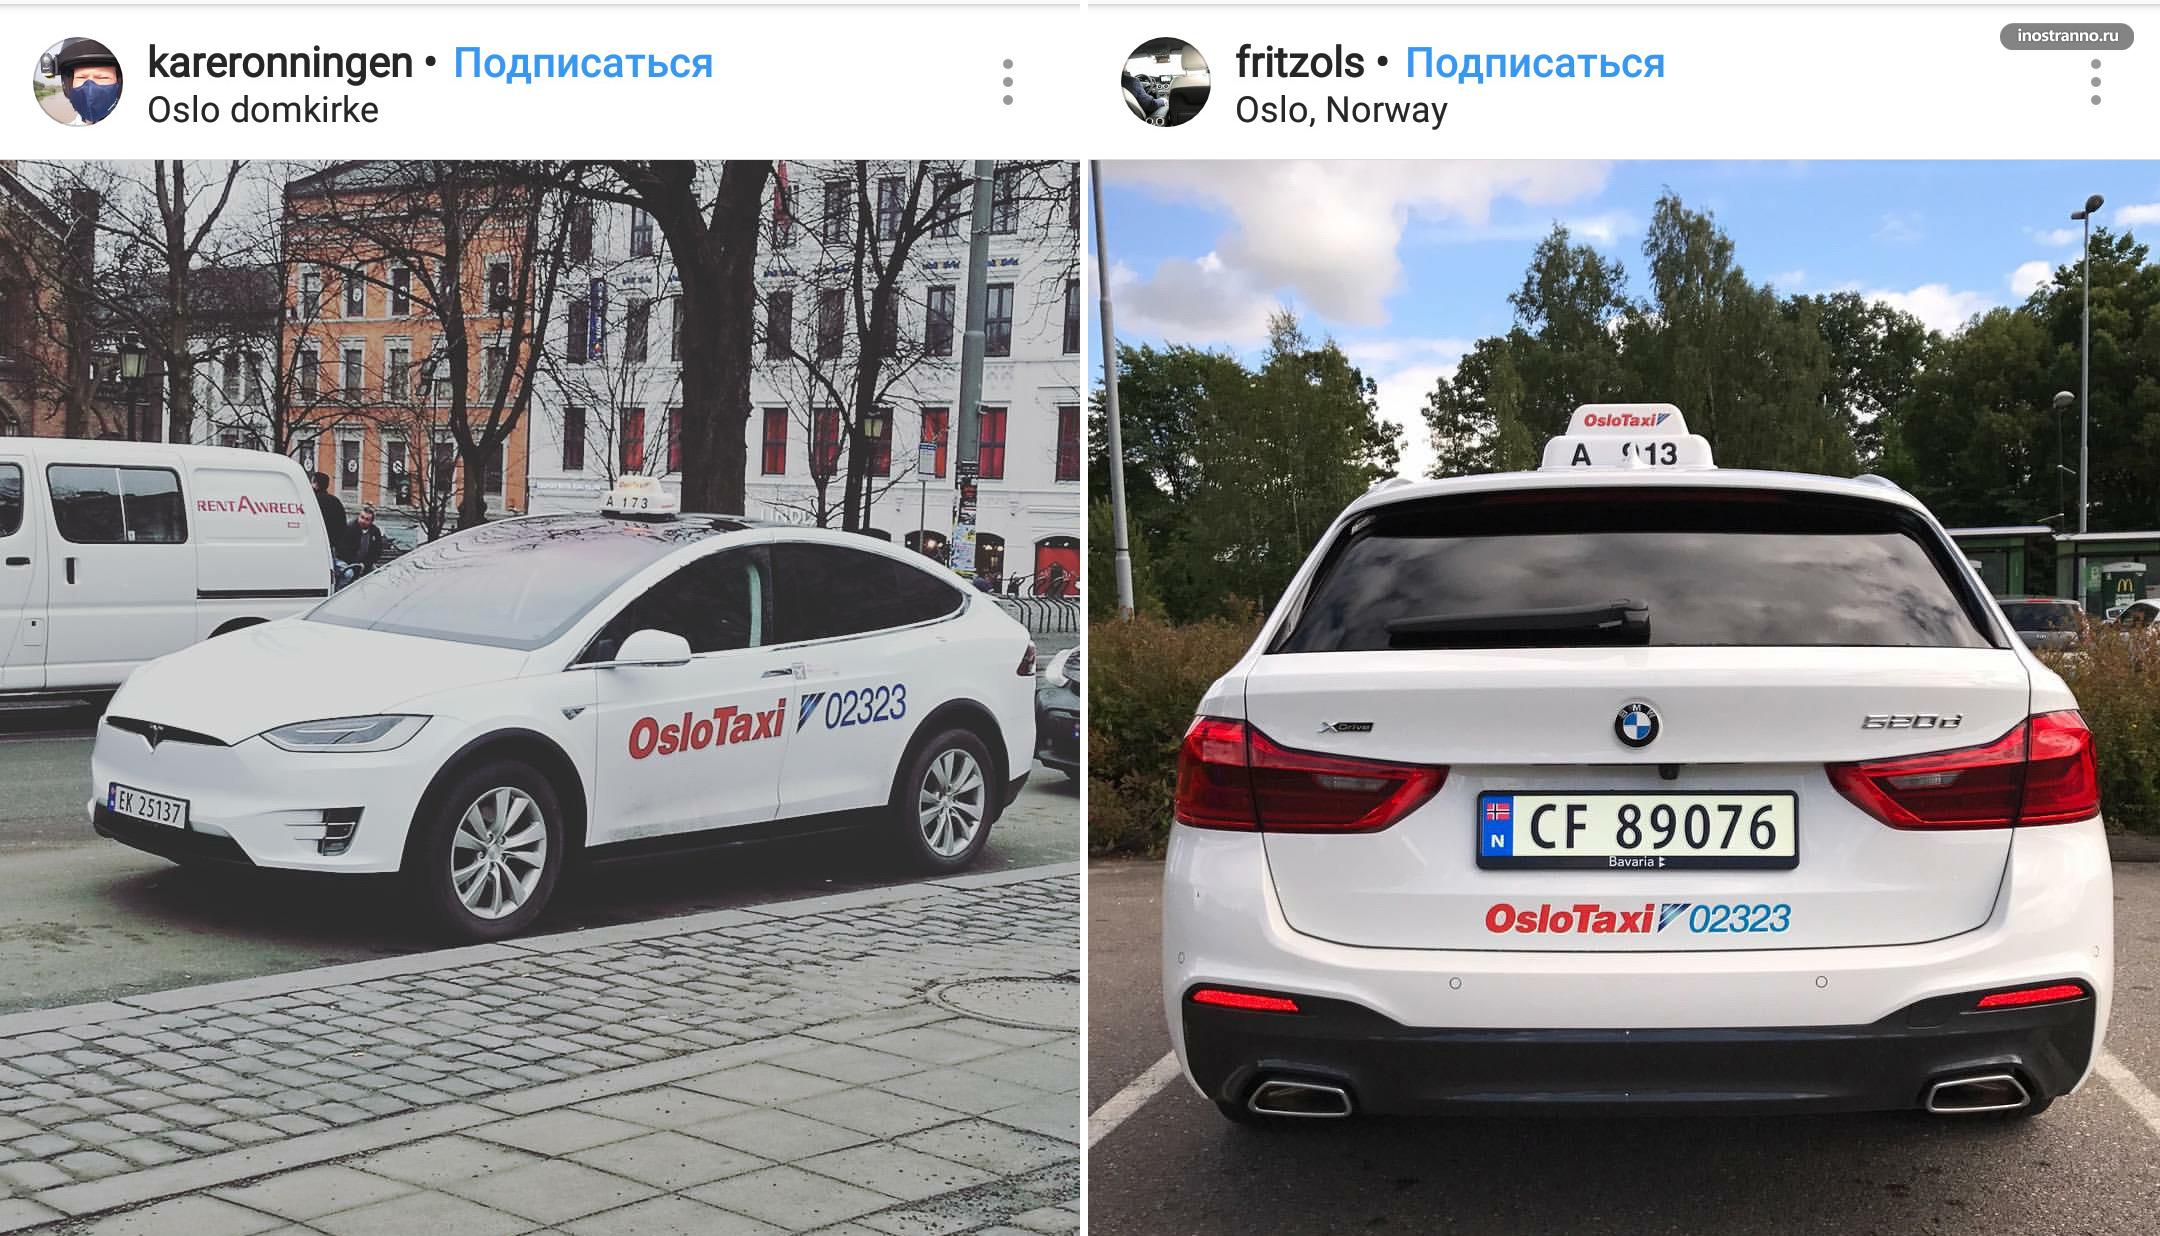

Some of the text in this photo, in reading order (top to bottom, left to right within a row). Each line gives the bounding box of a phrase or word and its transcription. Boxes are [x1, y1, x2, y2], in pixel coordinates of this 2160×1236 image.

[1584, 413, 1657, 427] OsloTaxi
[1570, 442, 1592, 467] A
[623, 496, 649, 509] 173
[628, 684, 907, 760] OsloTaxi 02323
[119, 790, 181, 824] EK 25137
[1530, 803, 1777, 850] CF 89076
[1491, 834, 1505, 848] N
[1608, 855, 1655, 868] Bavaria
[1485, 902, 1792, 935] OsloTaxi 02323
